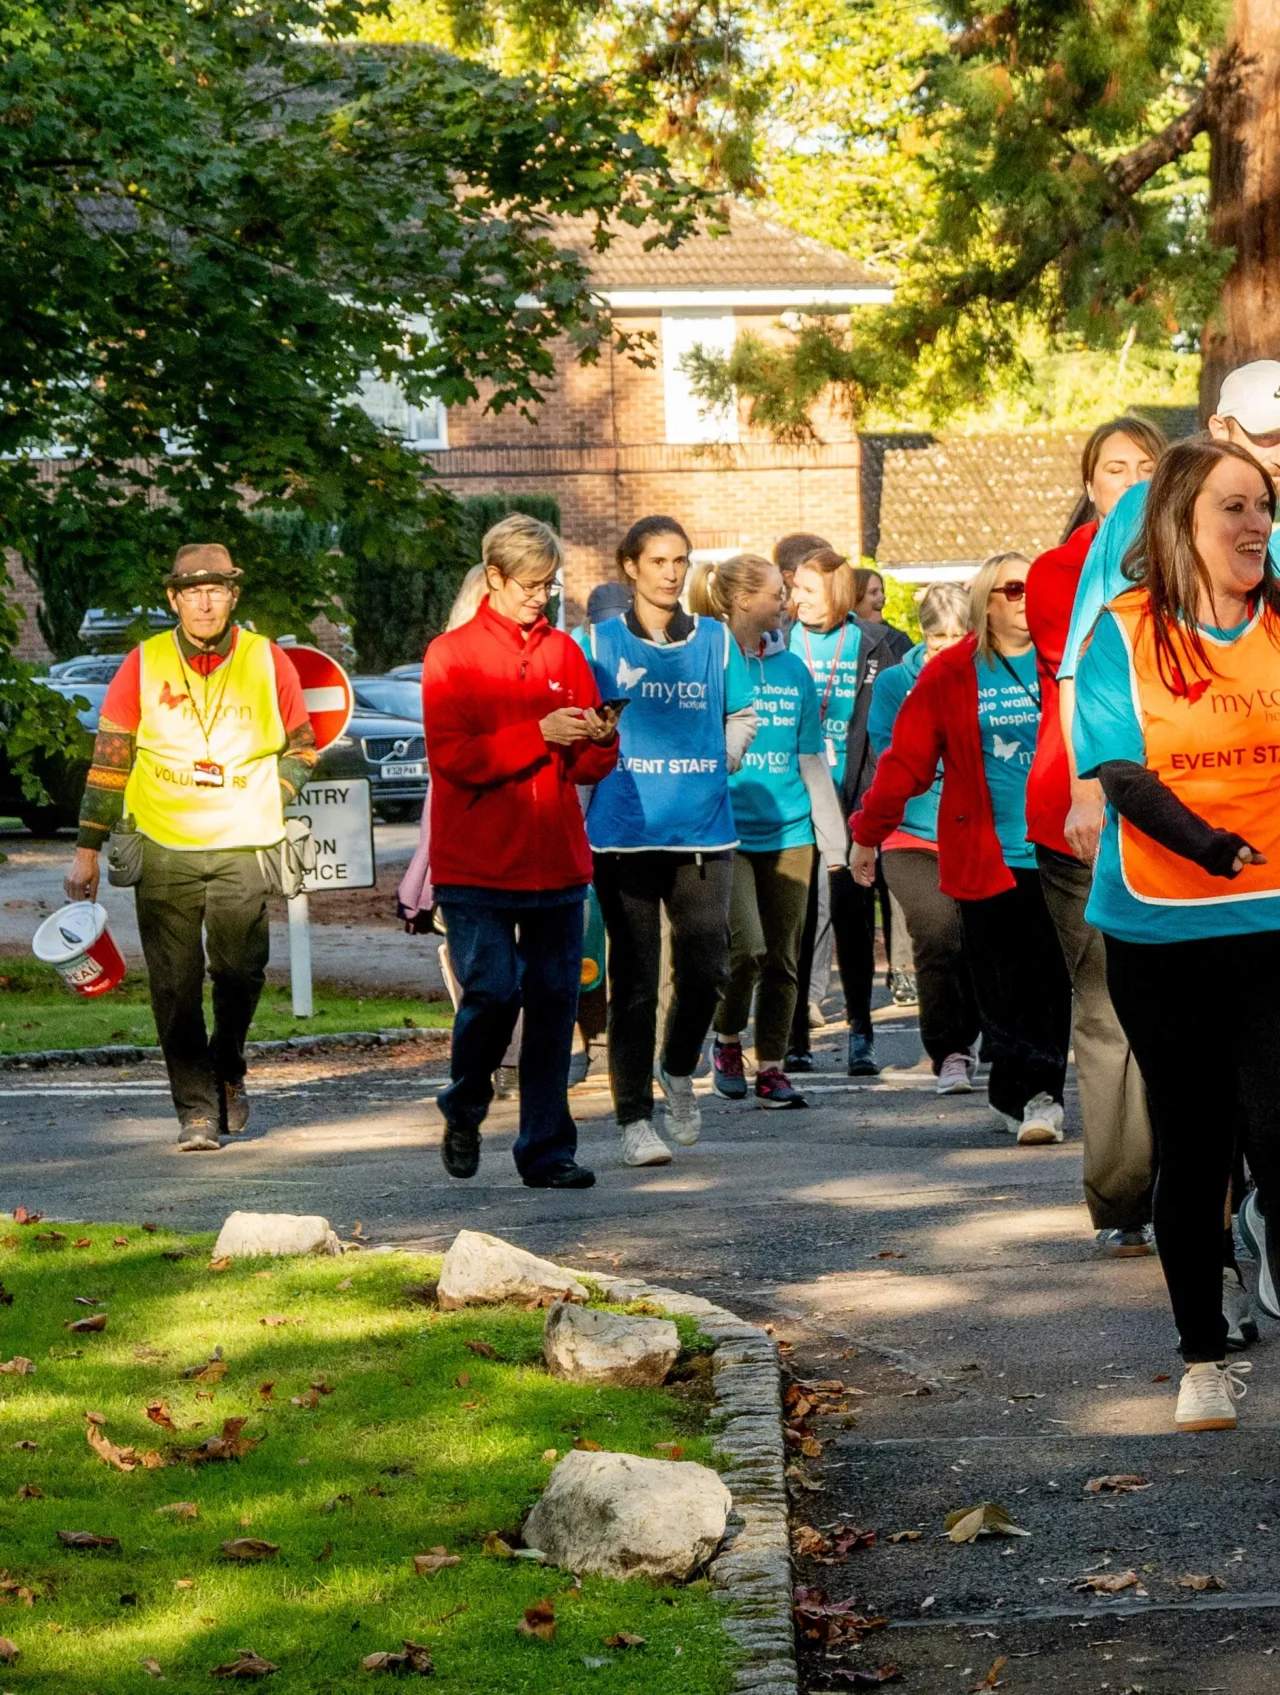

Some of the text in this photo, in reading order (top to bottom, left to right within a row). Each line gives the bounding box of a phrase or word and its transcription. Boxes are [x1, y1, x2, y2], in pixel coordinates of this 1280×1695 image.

[762, 684, 799, 696] should
[1000, 685, 1025, 695] one
[616, 757, 718, 774] EVENT STAFF
[1171, 748, 1247, 770] EVENT
